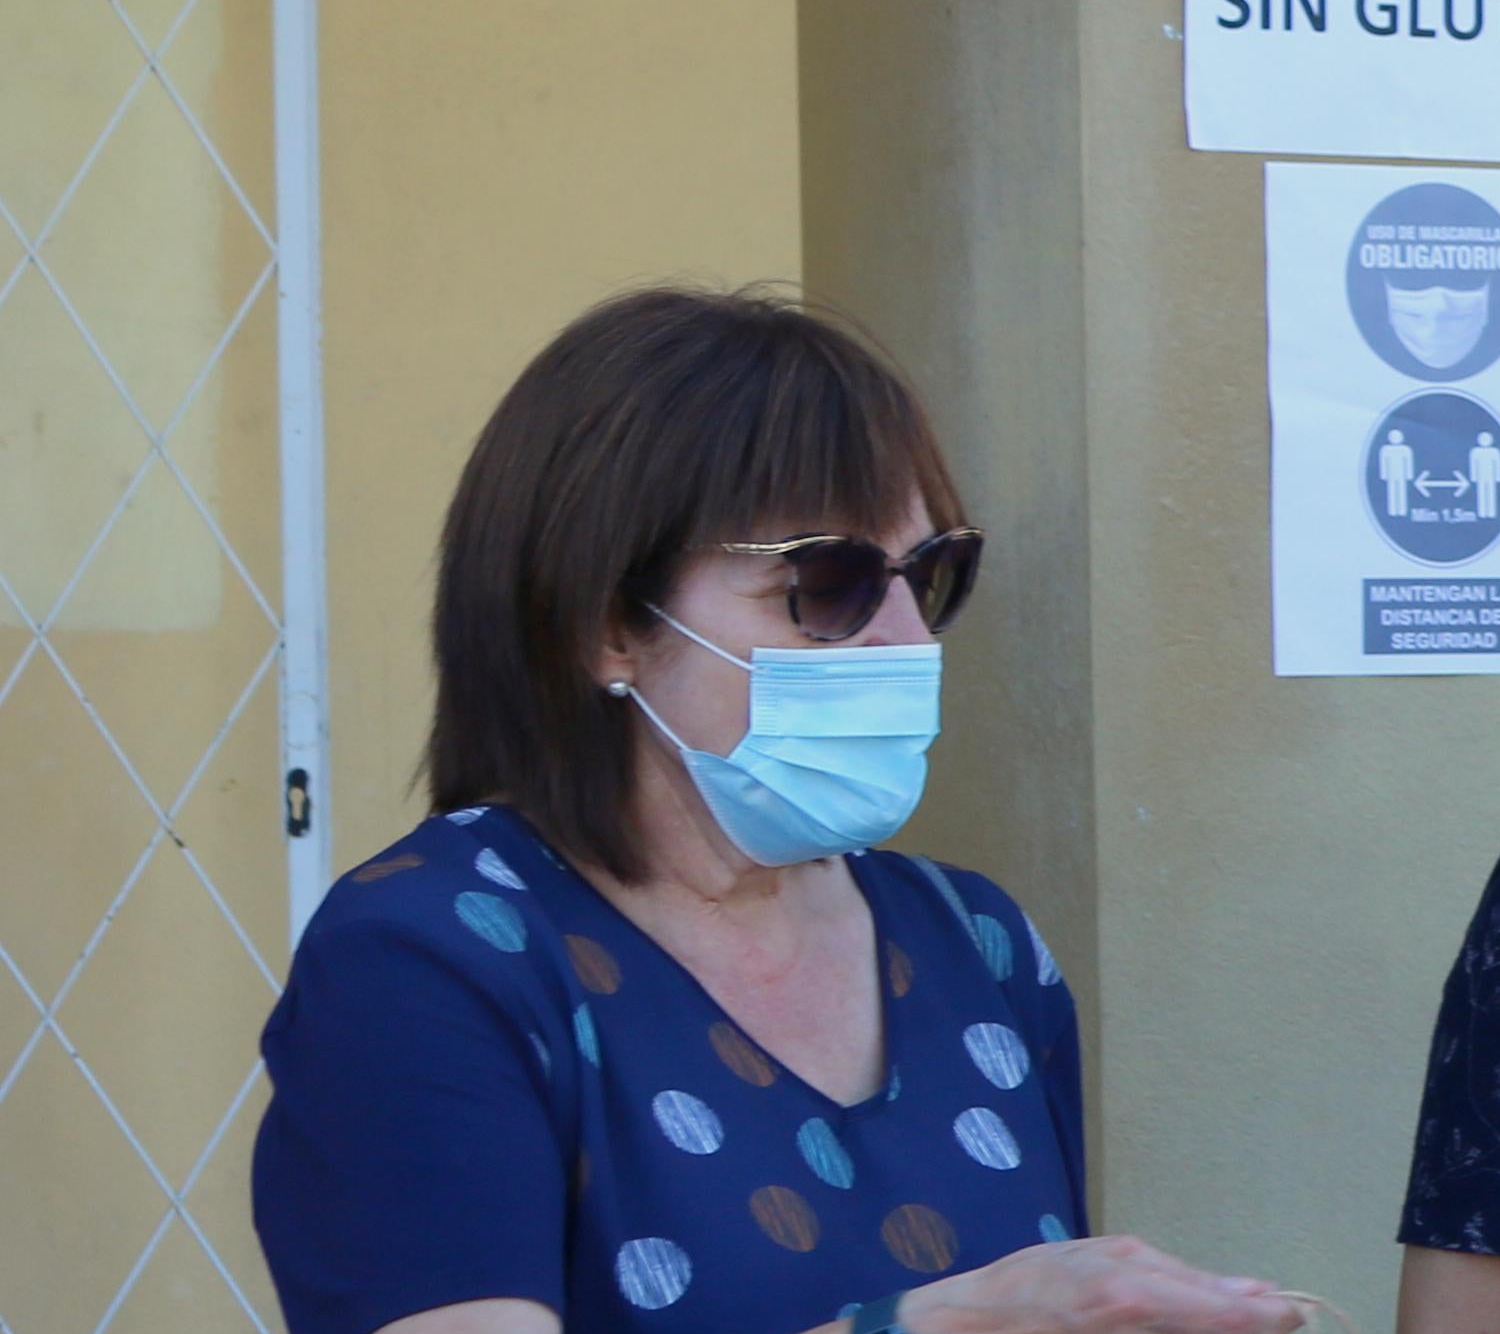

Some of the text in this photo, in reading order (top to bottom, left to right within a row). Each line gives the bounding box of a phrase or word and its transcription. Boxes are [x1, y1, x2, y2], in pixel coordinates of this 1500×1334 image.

[1366, 225, 1396, 240] USO
[1397, 225, 1417, 240] DE
[1369, 585, 1487, 602] MANTENGAN
[1380, 608, 1477, 626] DISTANCIA
[1390, 632, 1498, 650] SEGURIDAD
